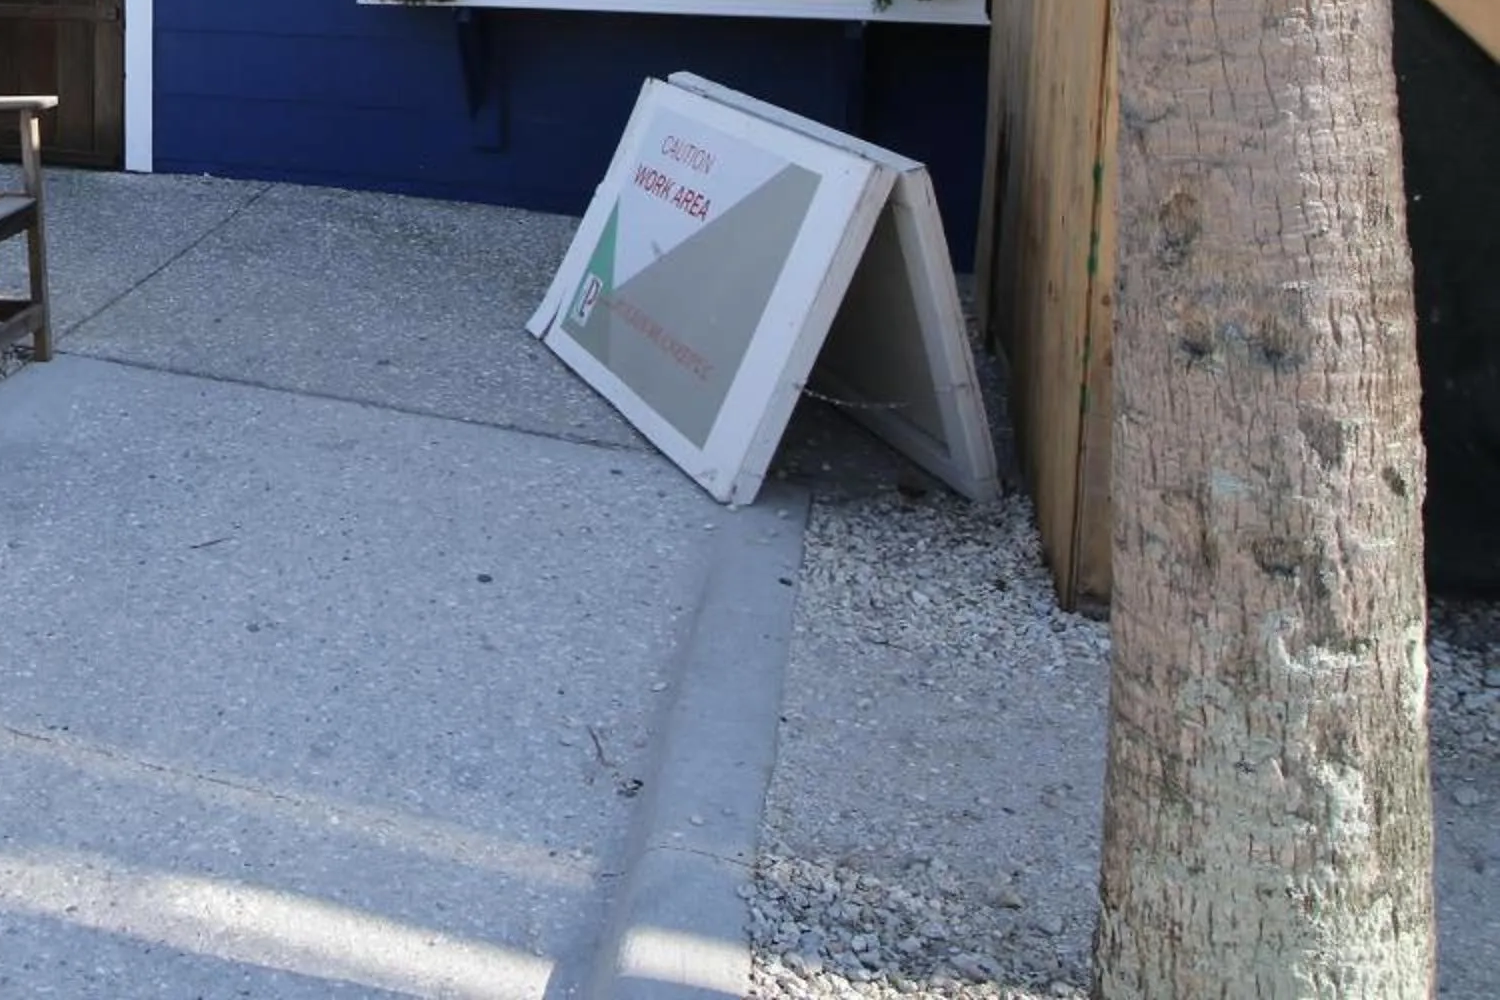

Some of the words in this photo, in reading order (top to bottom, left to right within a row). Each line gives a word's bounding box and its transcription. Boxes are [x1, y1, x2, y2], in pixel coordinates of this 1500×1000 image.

[661, 135, 716, 175] CAUTION
[634, 163, 676, 200] WORK
[671, 186, 711, 223] AREA
